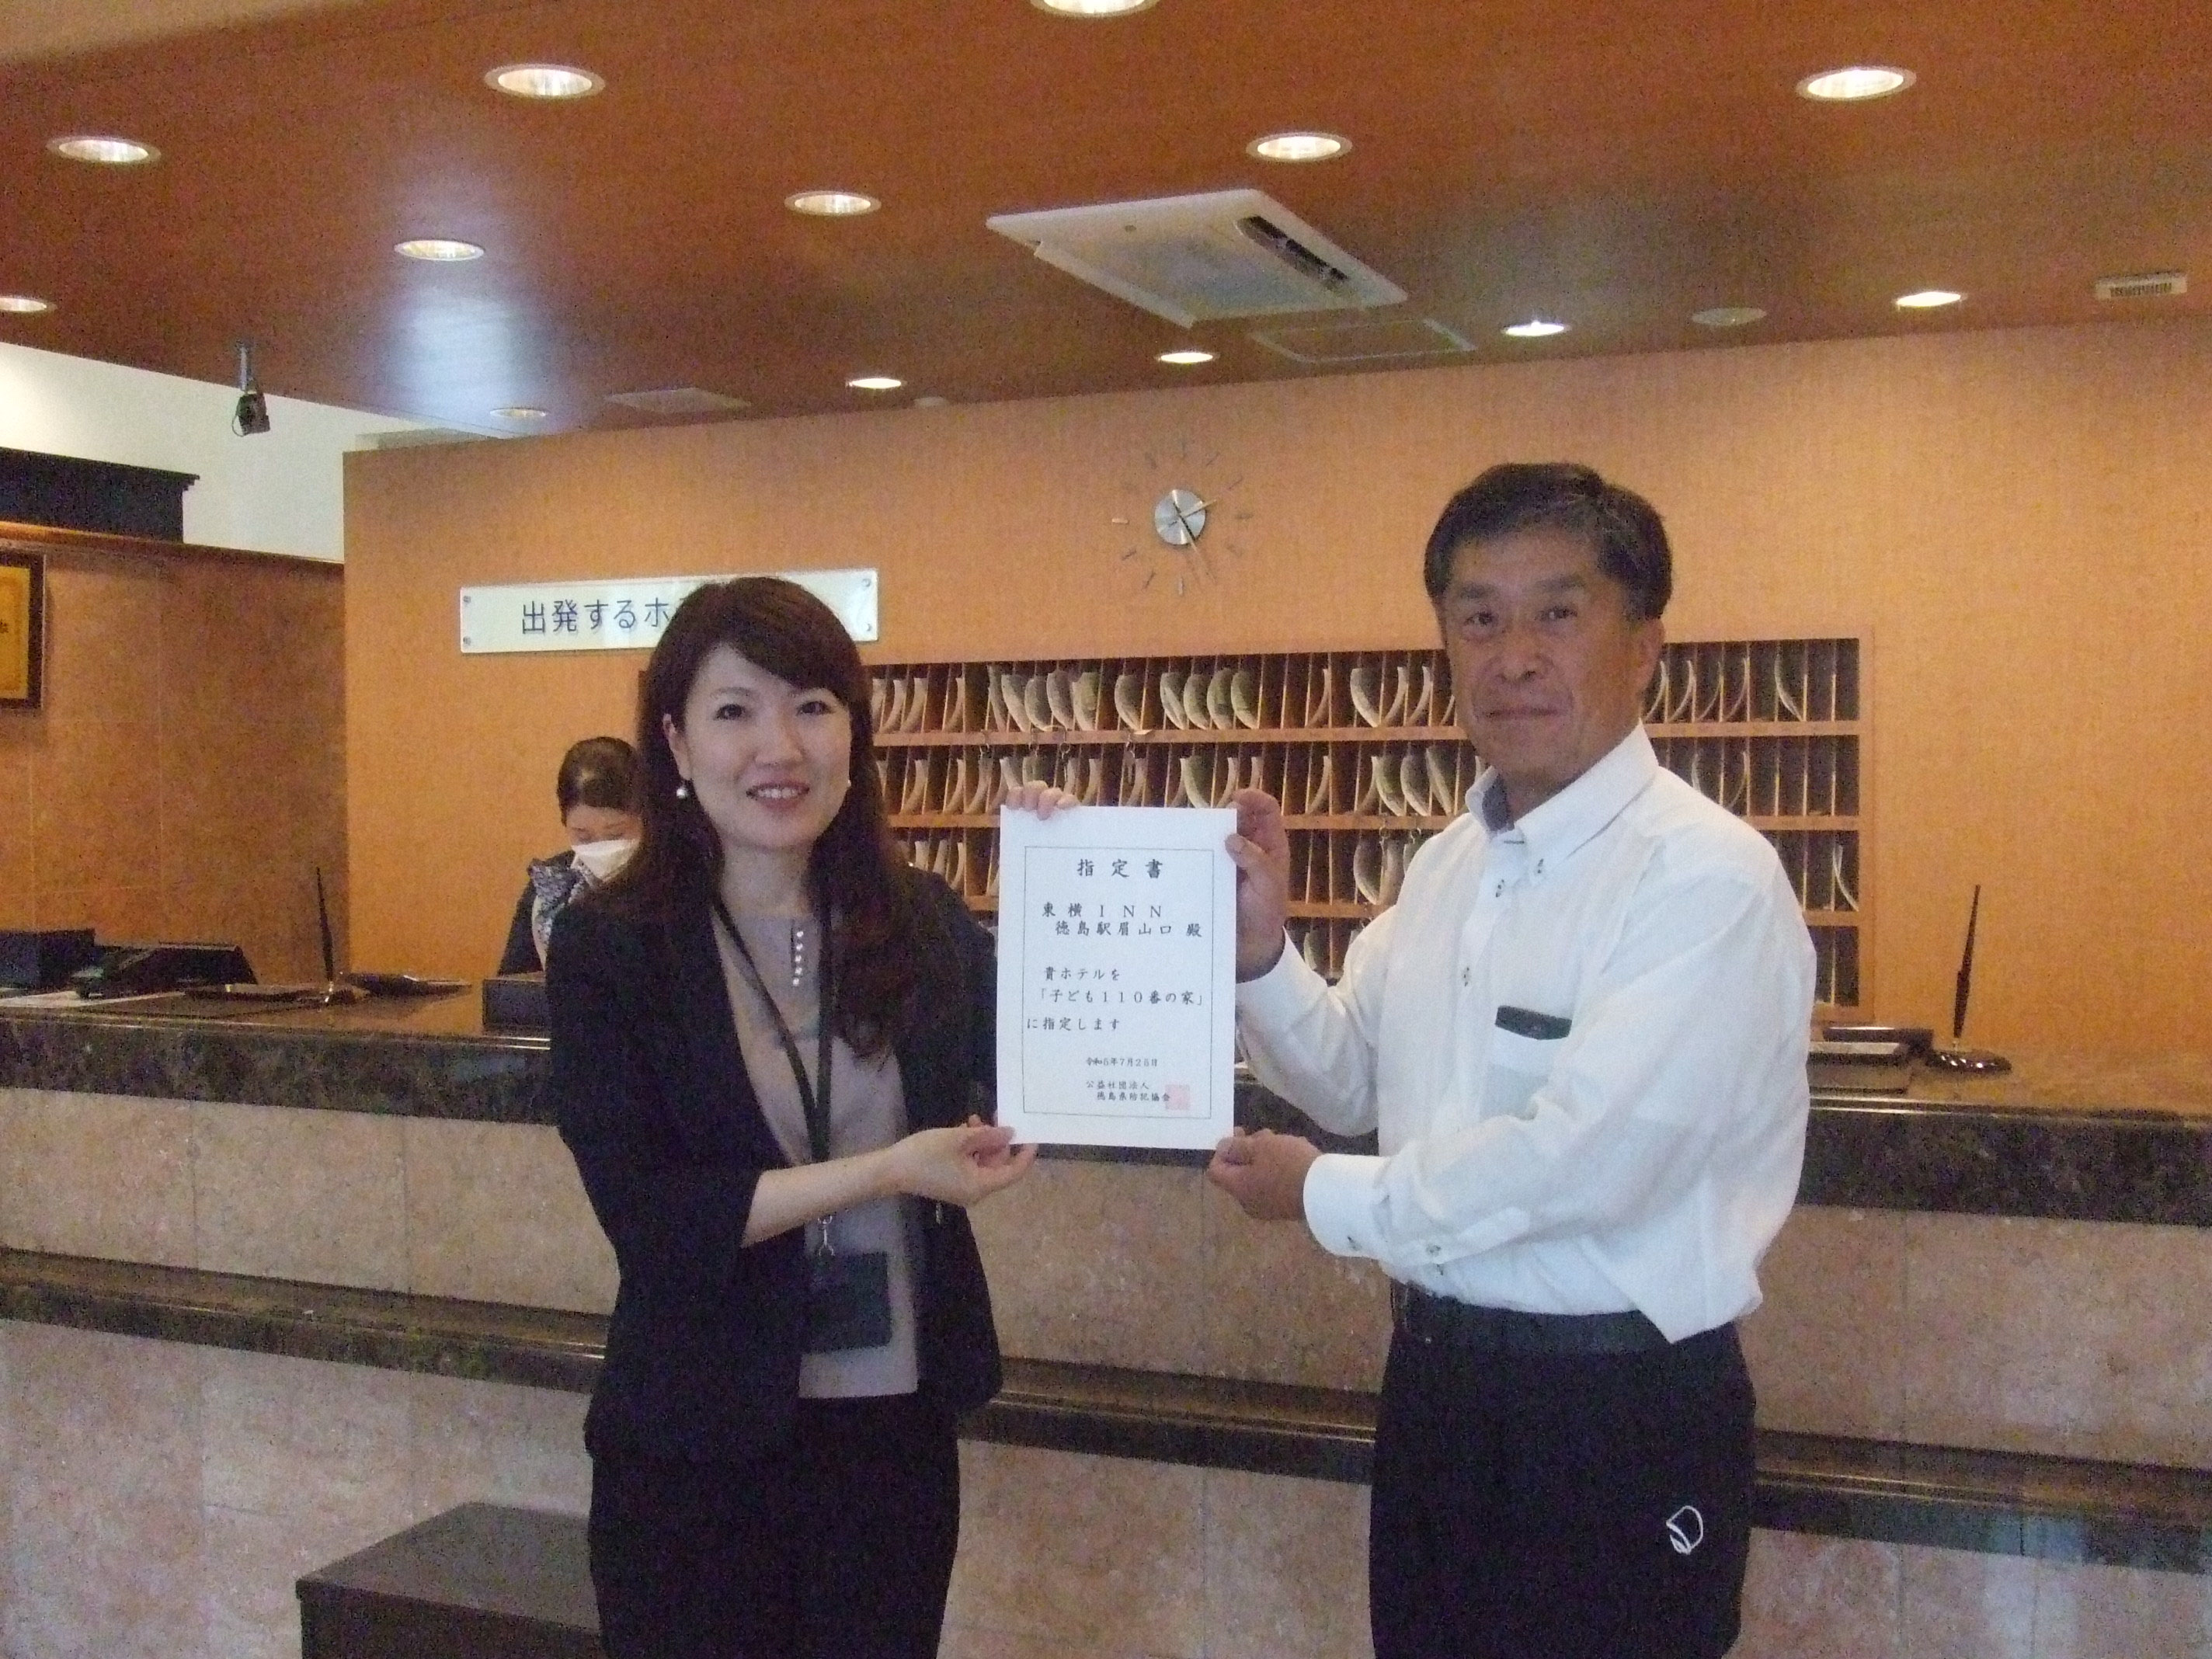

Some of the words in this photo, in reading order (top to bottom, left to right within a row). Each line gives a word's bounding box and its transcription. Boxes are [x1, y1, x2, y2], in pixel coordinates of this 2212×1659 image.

[522, 596, 687, 635] 出発するホ
[1077, 858, 1164, 878] 指定書
[1042, 902, 1162, 918] 東横INN
[1186, 923, 1203, 938] 殿
[1045, 966, 1120, 981] 貴ホテルを
[1027, 1017, 1121, 1031] に指定します
